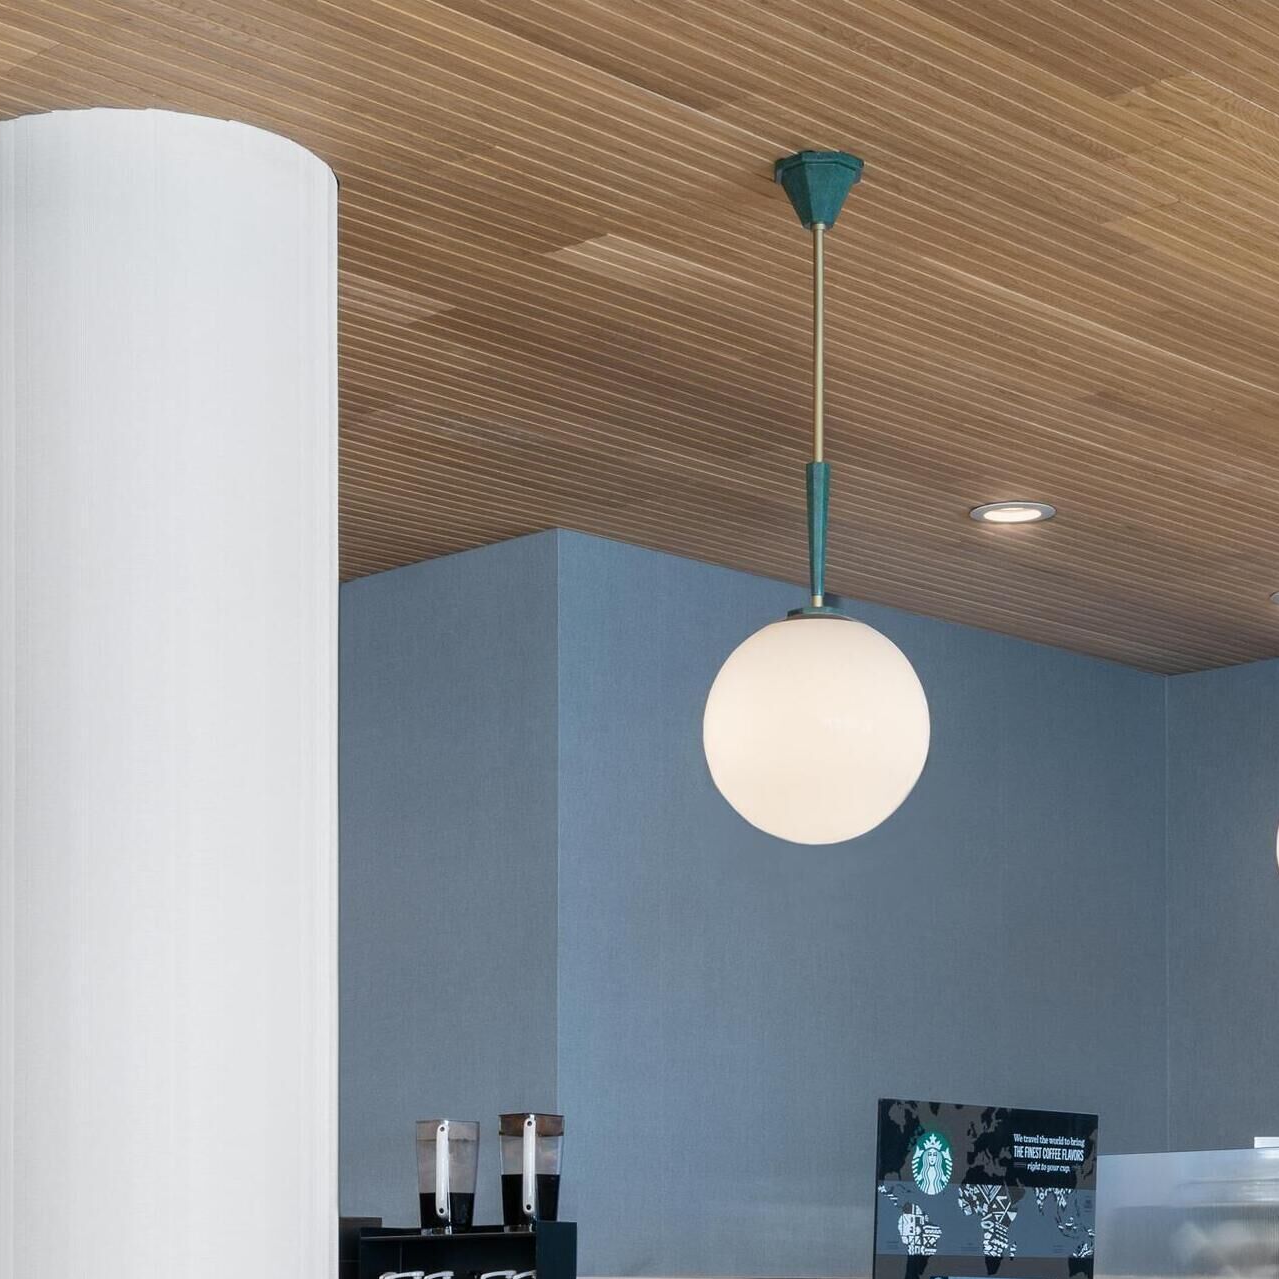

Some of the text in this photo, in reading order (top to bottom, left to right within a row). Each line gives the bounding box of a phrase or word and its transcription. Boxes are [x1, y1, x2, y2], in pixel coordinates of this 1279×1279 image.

[1013, 1133, 1086, 1149] We travel the world to bring
[1013, 1145, 1084, 1162] THE FINEST COFFEE FLAVORS
[1027, 1161, 1041, 1172] right
[1041, 1163, 1047, 1171] to
[1046, 1164, 1059, 1173] your
